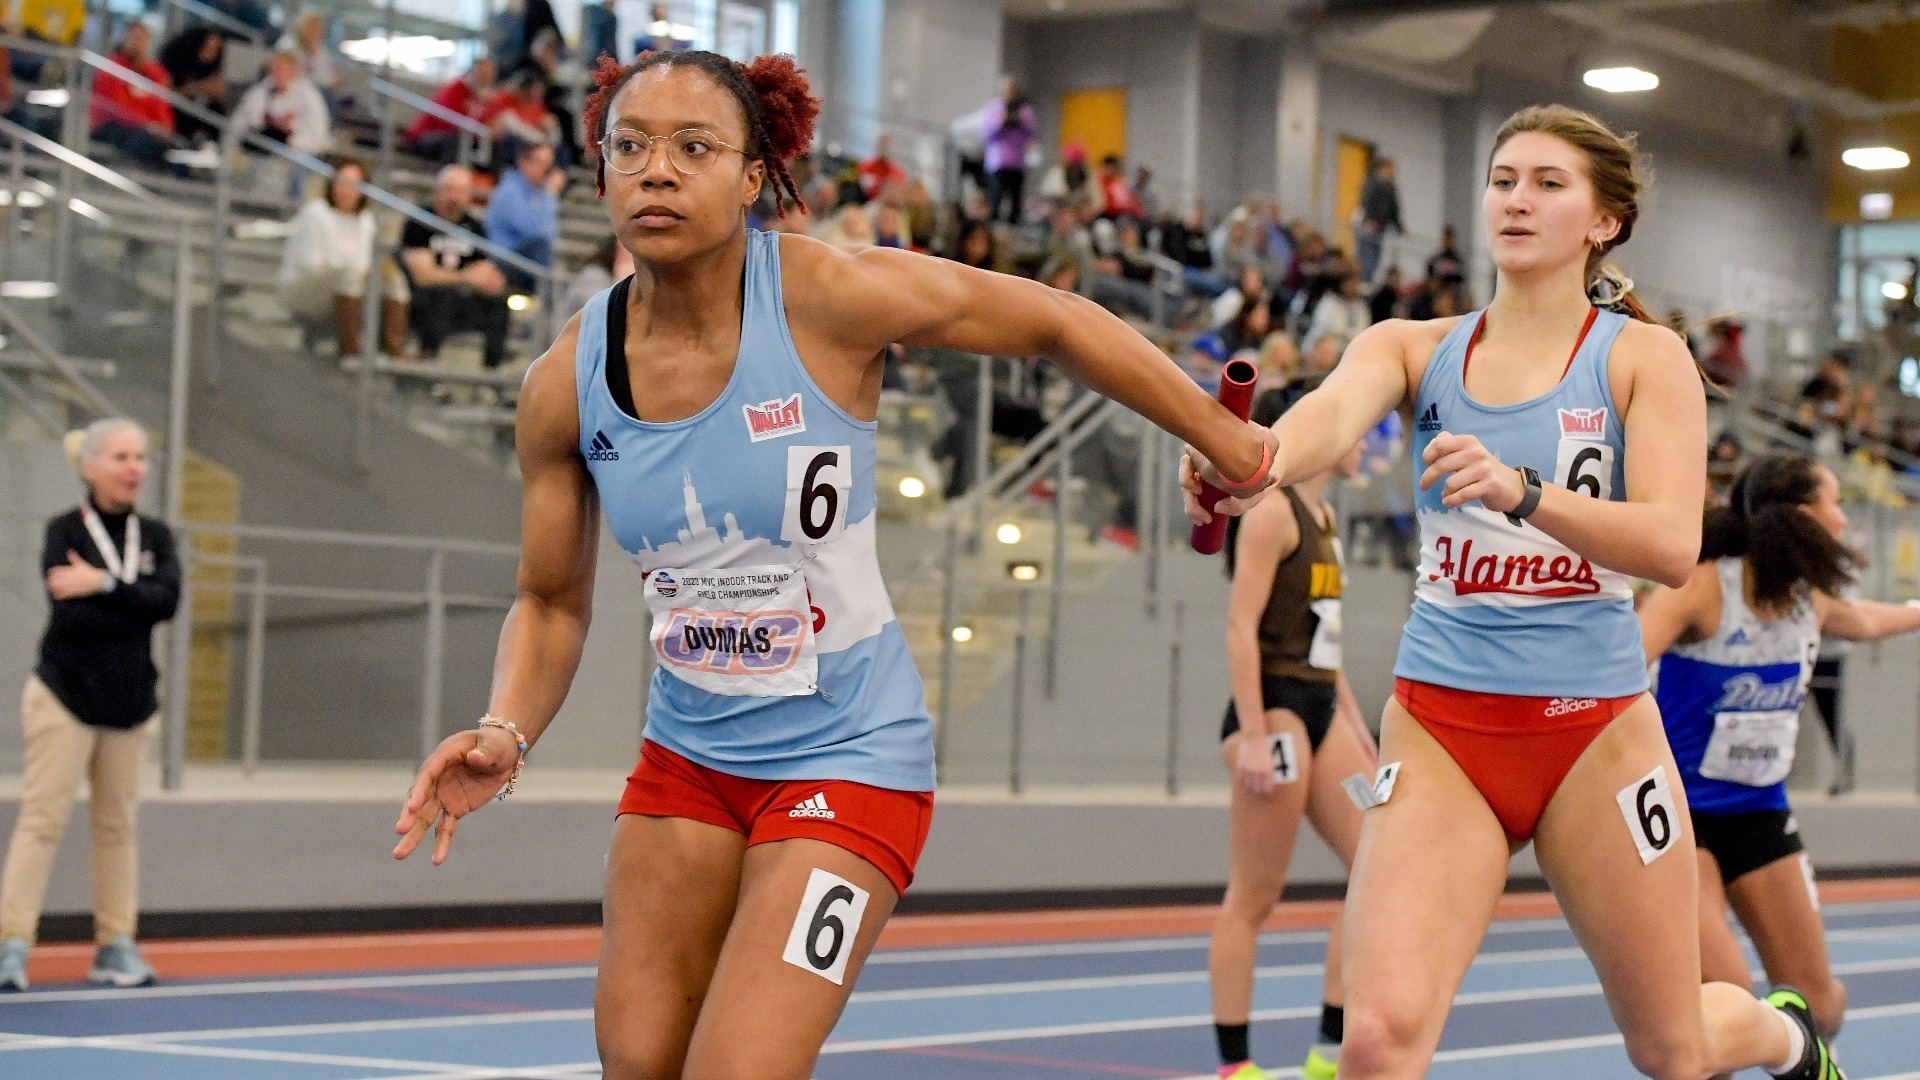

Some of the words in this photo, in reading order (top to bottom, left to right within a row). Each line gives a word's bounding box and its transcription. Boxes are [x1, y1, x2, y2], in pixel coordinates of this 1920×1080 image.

[747, 397, 800, 433] VALLEY
[764, 403, 780, 411] THE
[1560, 410, 1605, 432] VALLEY
[1566, 447, 1602, 499] 6
[799, 451, 838, 540] 6
[701, 578, 716, 587] MVC
[717, 576, 746, 587] INDOOR
[747, 574, 771, 585] TRACK
[773, 573, 789, 584] AND
[1429, 536, 1600, 596] Flames
[697, 590, 717, 600] FIELD
[718, 587, 780, 599] CHAMPIONSHIPS
[658, 610, 806, 674] UIC
[684, 624, 771, 654] DUMAS
[1544, 698, 1598, 718] adidas
[788, 806, 836, 820] adidas
[1635, 778, 1671, 851] 6
[805, 884, 855, 971] 6
